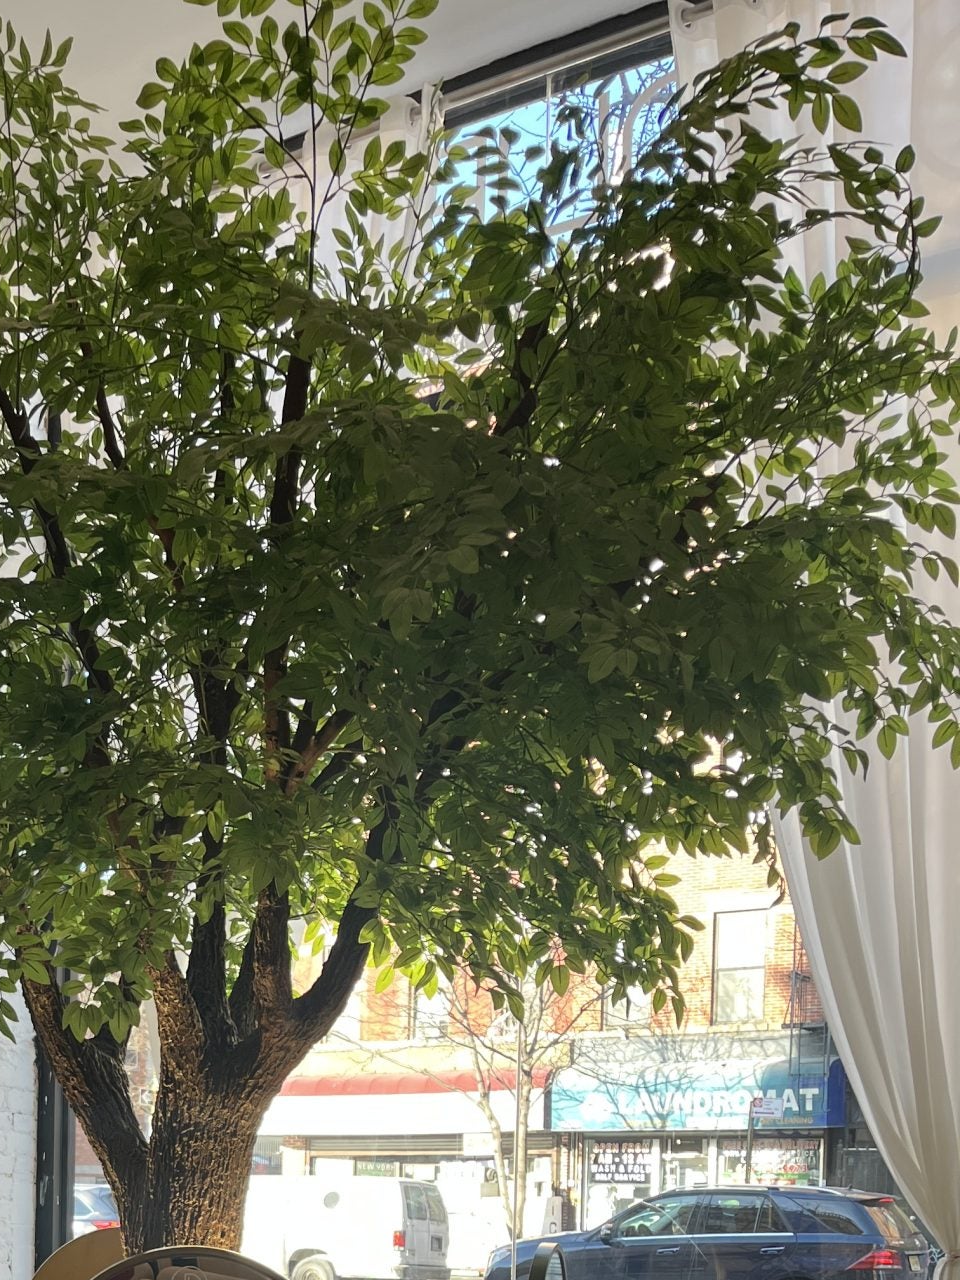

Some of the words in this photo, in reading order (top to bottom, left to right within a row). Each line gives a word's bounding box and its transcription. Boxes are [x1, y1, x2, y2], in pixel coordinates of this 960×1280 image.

[592, 1142, 619, 1154] OPEN
[622, 1142, 650, 1154] FROM
[598, 1153, 613, 1164] AM
[591, 1164, 616, 1173] WASH
[618, 1164, 626, 1173] &
[627, 1164, 652, 1173] FOLD
[595, 1173, 612, 1181] SELF
[614, 1173, 645, 1182] SERVICE
